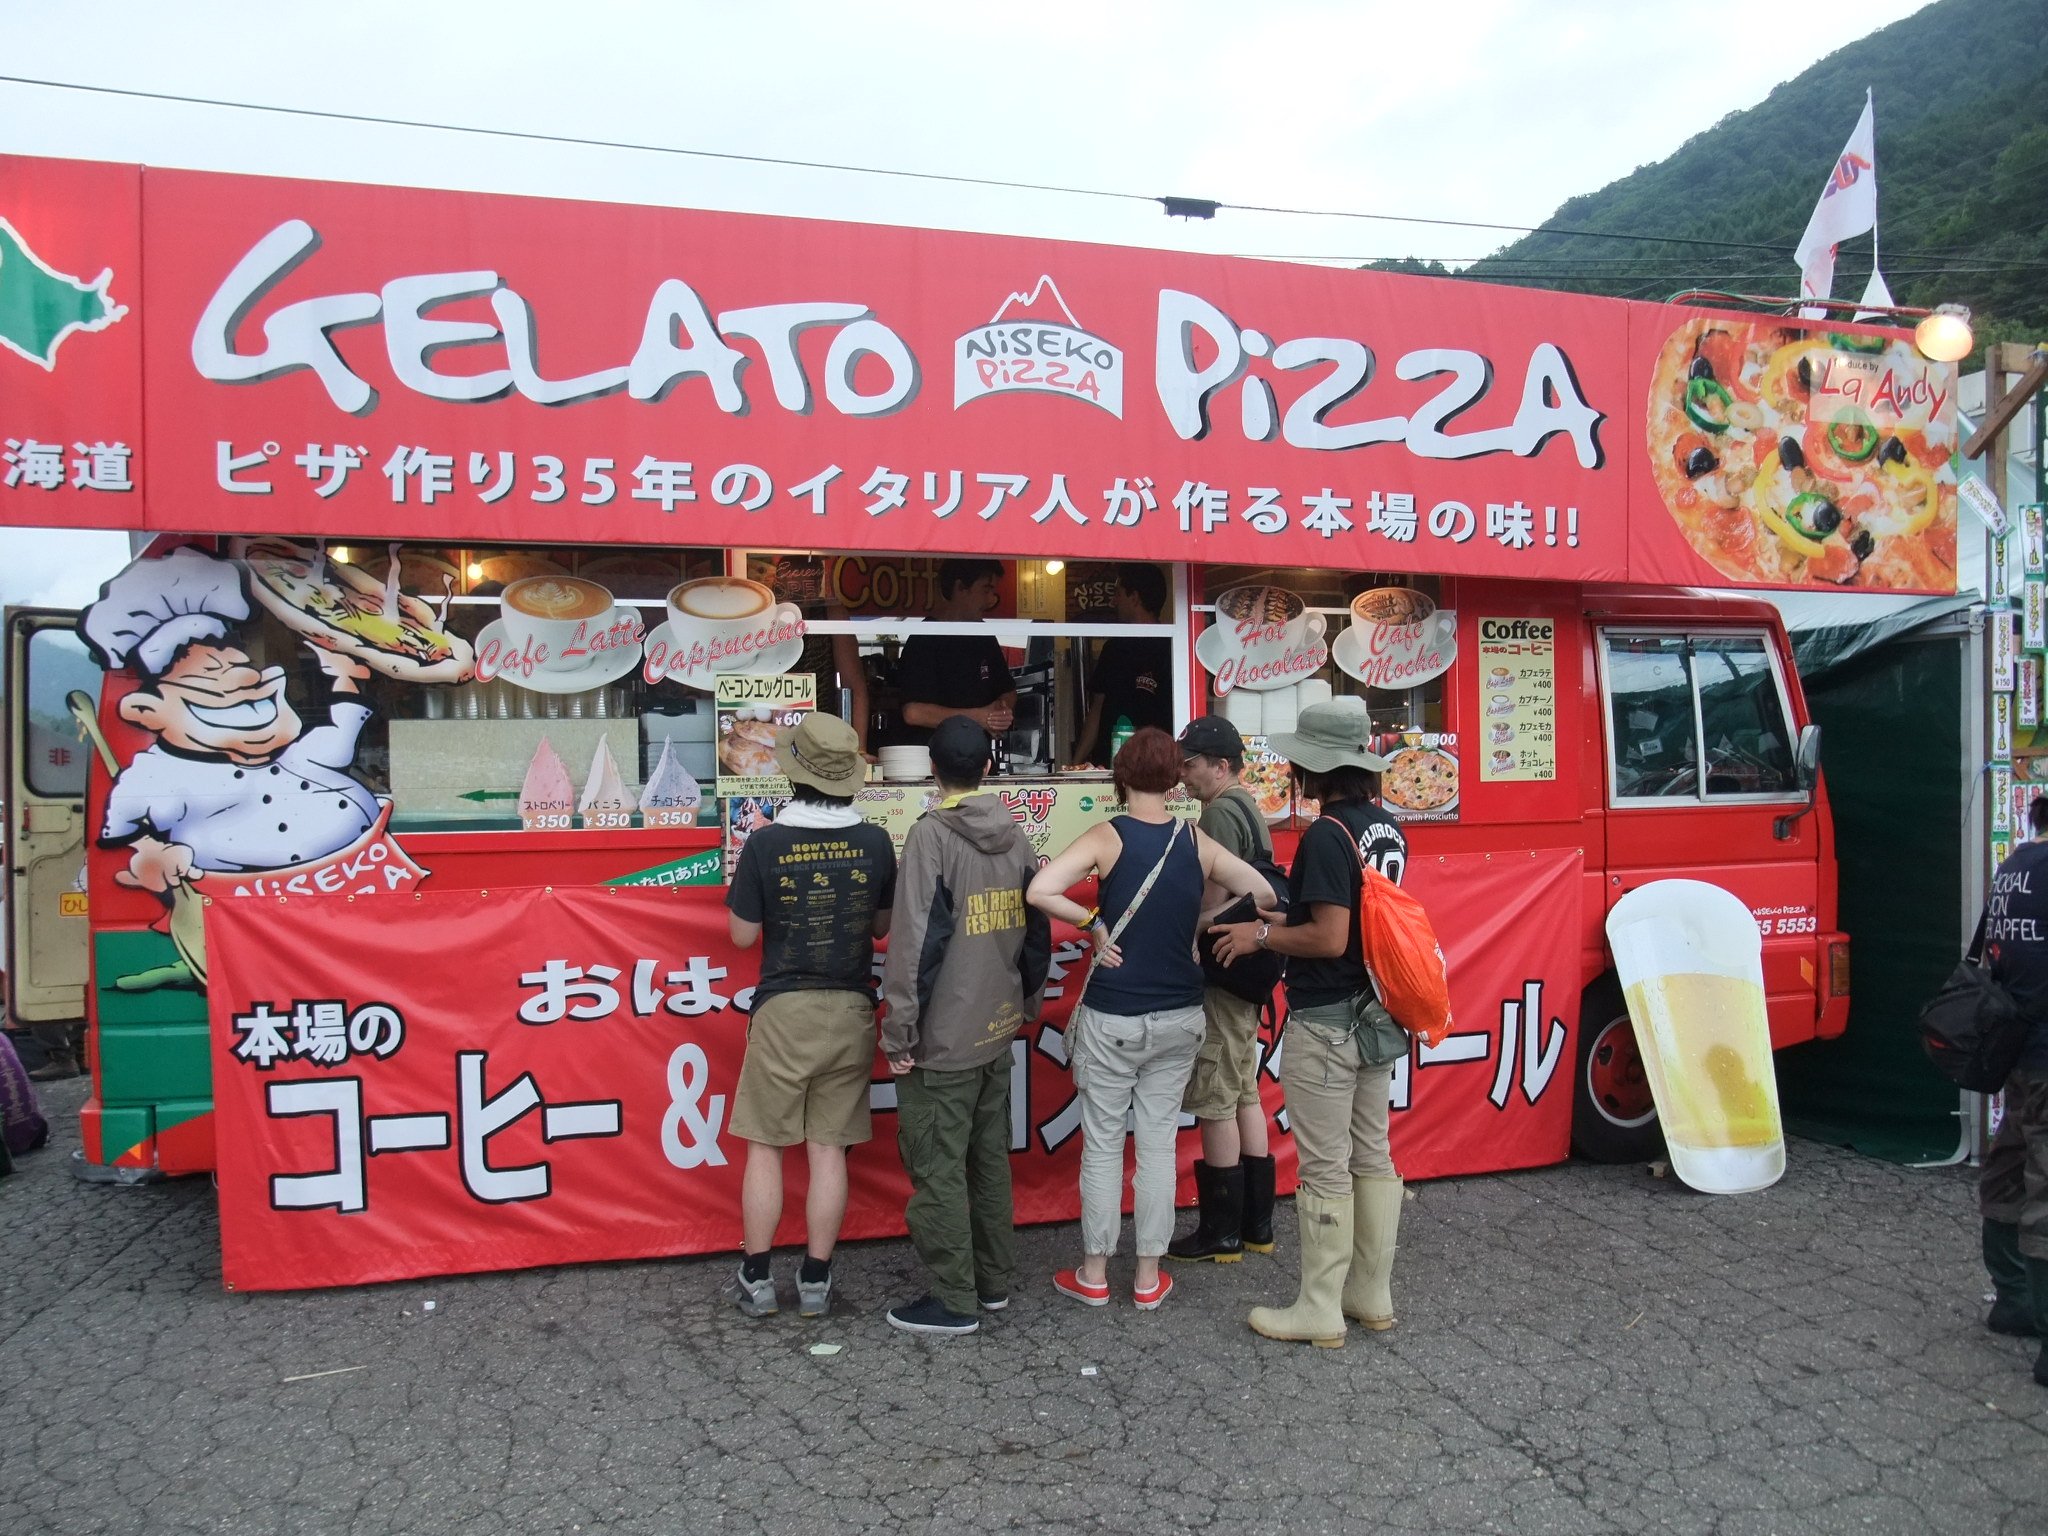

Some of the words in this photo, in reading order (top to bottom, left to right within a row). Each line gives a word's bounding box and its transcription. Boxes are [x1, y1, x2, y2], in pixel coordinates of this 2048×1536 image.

[191, 218, 920, 417] GELATO
[1869, 366, 1949, 424] Andy
[215, 440, 1580, 550] ピザ作り35年のイタリア人が作る本場の味!!
[1234, 617, 1289, 650] Hot
[1369, 613, 1426, 657] Cafe
[1481, 620, 1553, 640] Coffee
[474, 634, 551, 684] Cafe
[560, 619, 648, 661] Latte
[643, 618, 810, 686] Cappuccino
[1482, 643, 1553, 656] 本場のコーヒー
[1213, 642, 1329, 698] Chocolate
[1359, 648, 1443, 689] Mocha
[1520, 669, 1552, 678] カフェラテ
[718, 676, 812, 699] ベーコンエッグロール
[1520, 722, 1552, 731] カフェモカ
[1520, 749, 1538, 758] ホット
[1520, 758, 1554, 767] チョコレート
[523, 800, 571, 811] ストロベリー
[588, 798, 622, 811] バニラ
[1000, 787, 1058, 823] ピザ
[525, 814, 571, 829] ¥350
[585, 812, 630, 828] ¥350
[648, 811, 693, 826] ¥350
[1424, 812, 1459, 821] Prosciutto
[792, 843, 821, 853] HOW
[823, 841, 849, 851] YOU
[827, 848, 864, 860] THAT!
[990, 888, 1024, 911] ROCK
[1776, 916, 1817, 935] 5553
[1994, 918, 2045, 941] APFEL
[234, 1001, 404, 1067] 本場の
[661, 1042, 729, 1169] &
[266, 1050, 622, 1214] コーヒー
